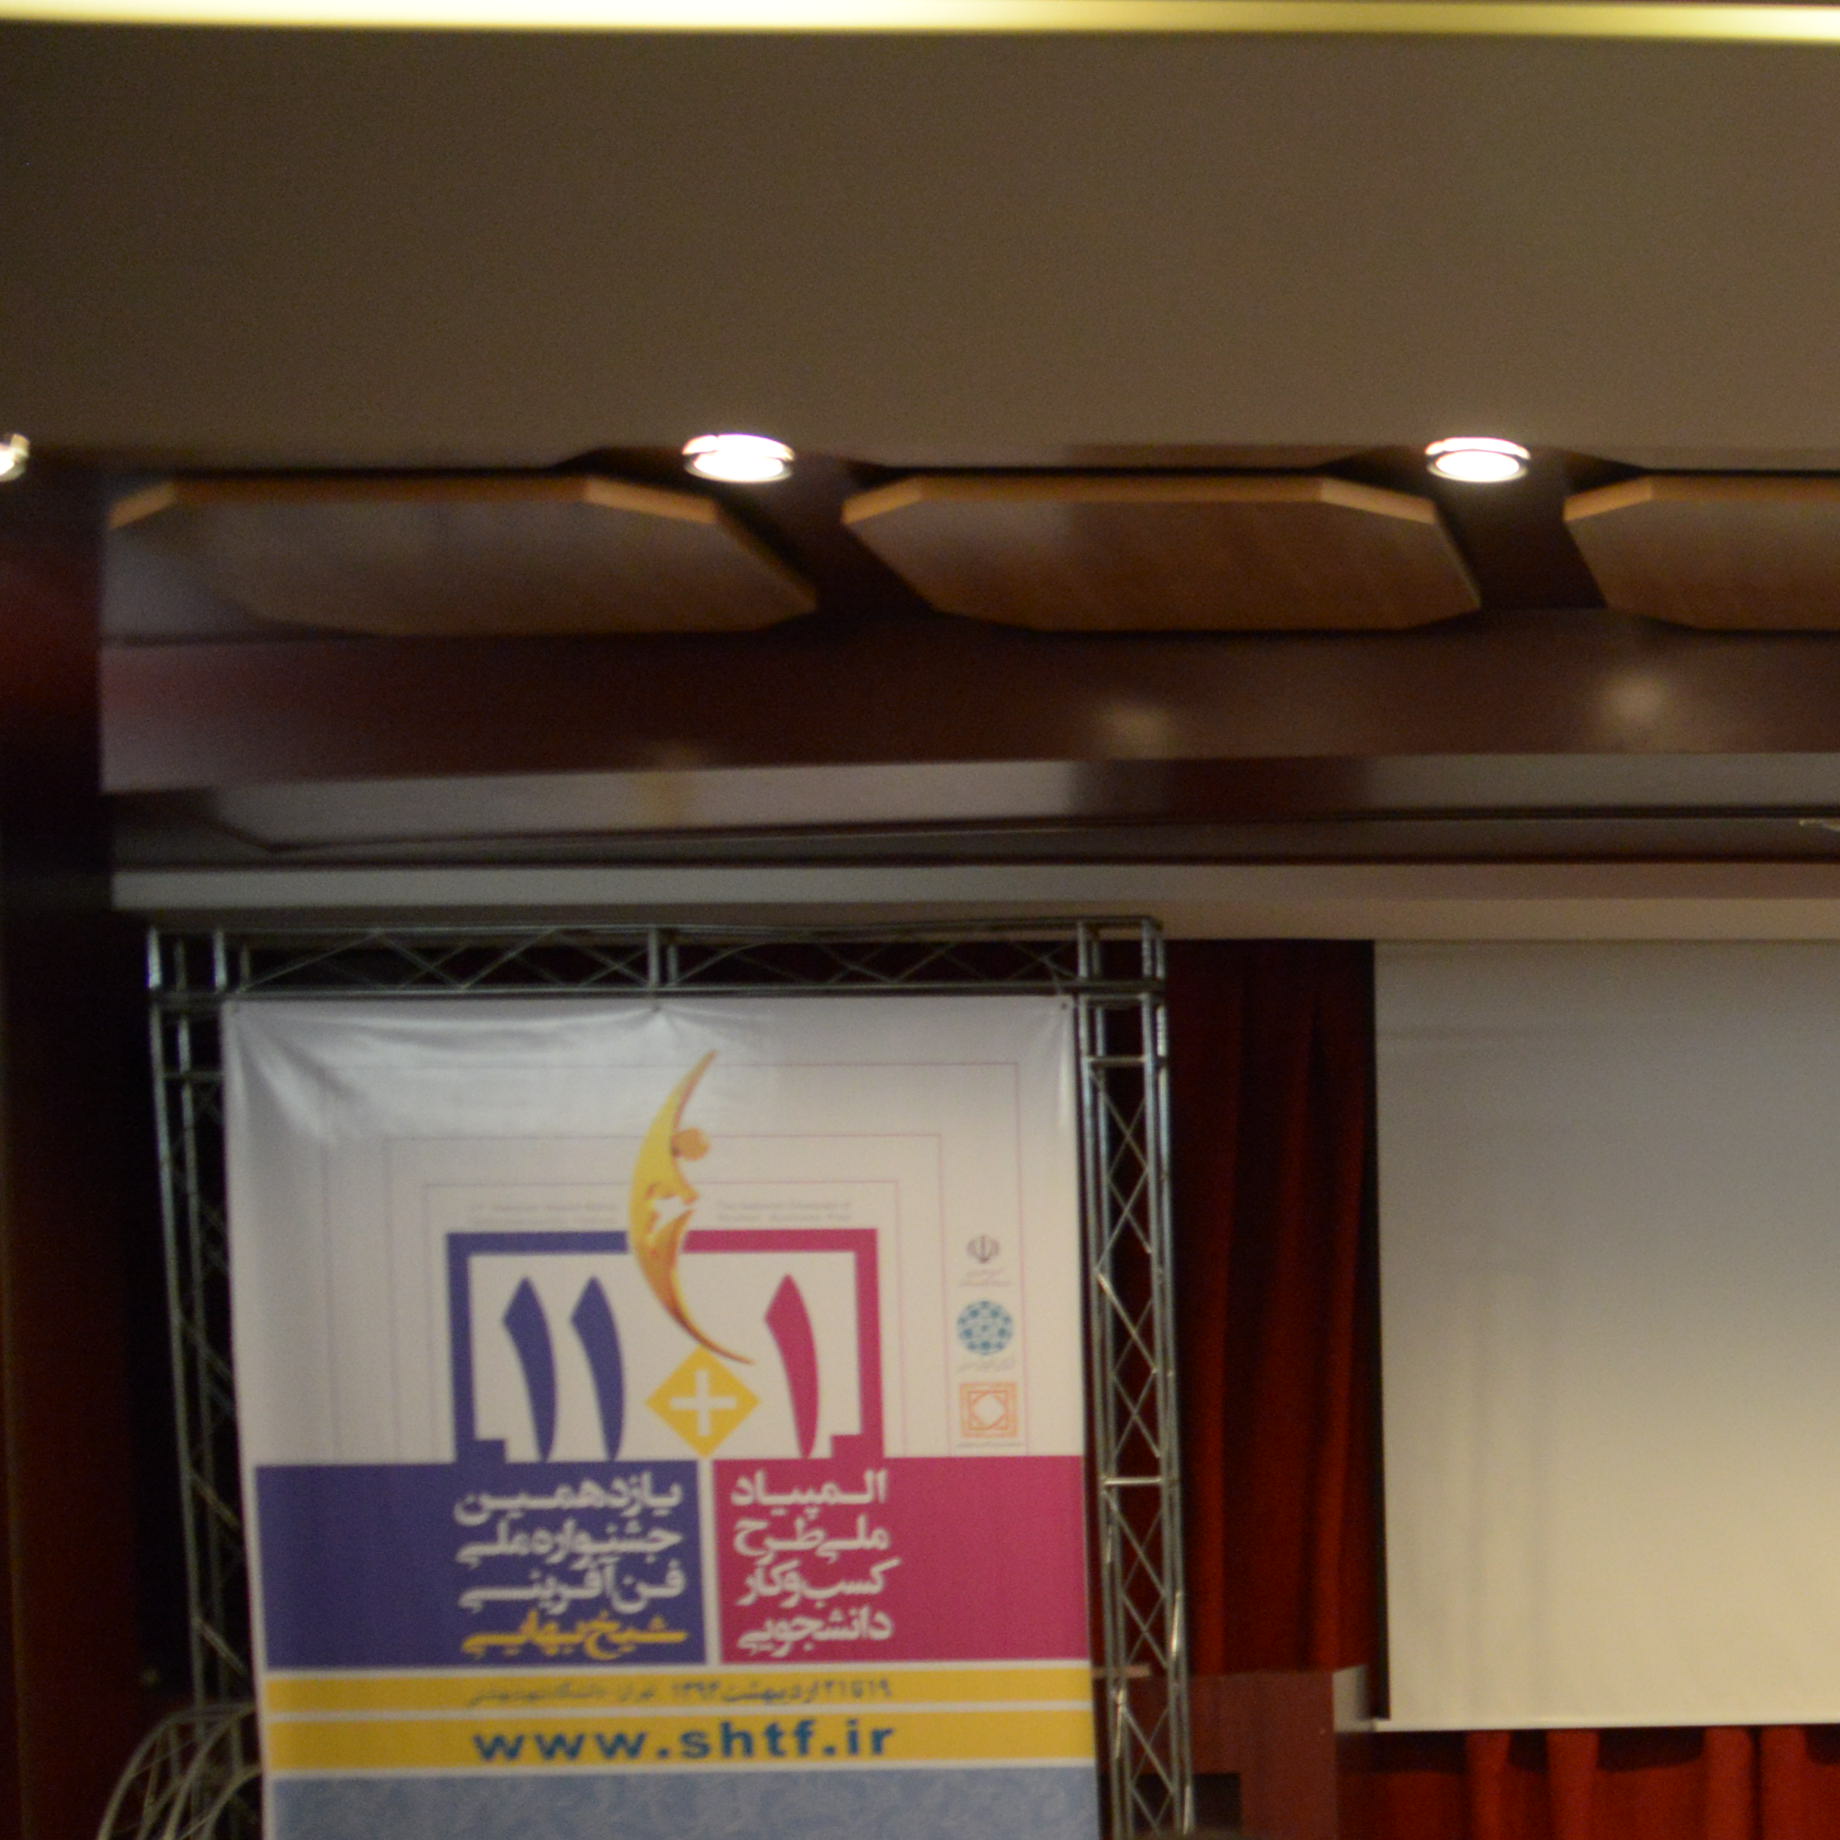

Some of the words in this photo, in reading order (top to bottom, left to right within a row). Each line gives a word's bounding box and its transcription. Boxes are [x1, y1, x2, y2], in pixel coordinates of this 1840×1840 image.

[453, 1470, 683, 1526] یازدهمین
[731, 1468, 889, 1520] المپیاد
[455, 1516, 531, 1571] ملی
[529, 1516, 684, 1571] جشنواره
[732, 1515, 827, 1564] طرح
[816, 1513, 891, 1563] ملی
[460, 1608, 587, 1659] بهایی
[583, 1609, 689, 1660] شیخ
[737, 1604, 895, 1658] دانشجویی
[471, 1717, 895, 1763] www.shtf.ir
